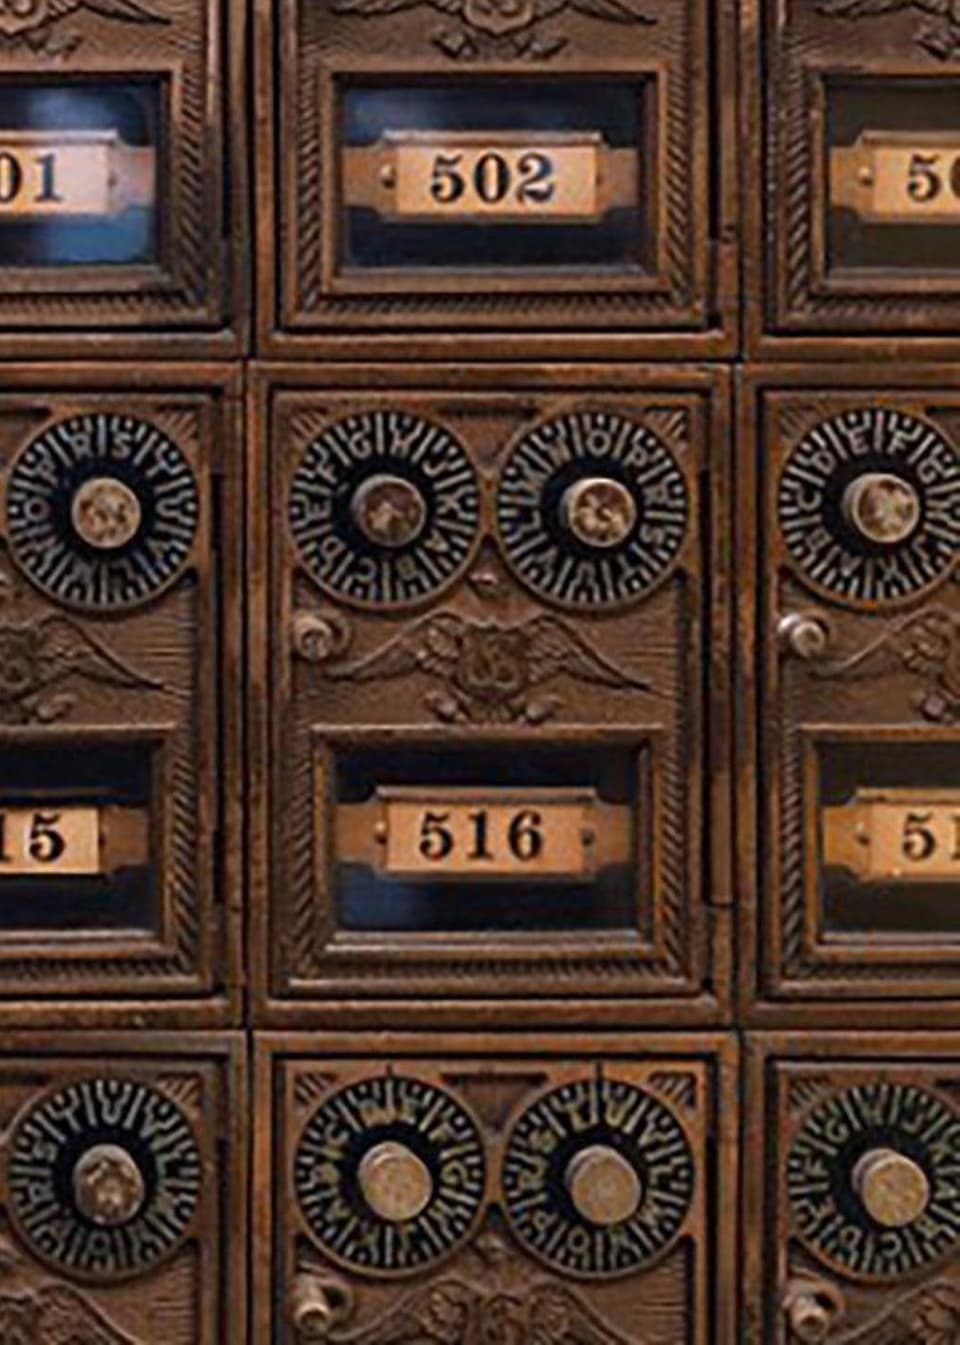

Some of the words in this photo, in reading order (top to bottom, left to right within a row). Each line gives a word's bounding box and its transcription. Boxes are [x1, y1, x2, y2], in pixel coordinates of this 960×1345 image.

[430, 152, 555, 205] 502
[908, 153, 960, 204] 5
[419, 810, 544, 862] 516
